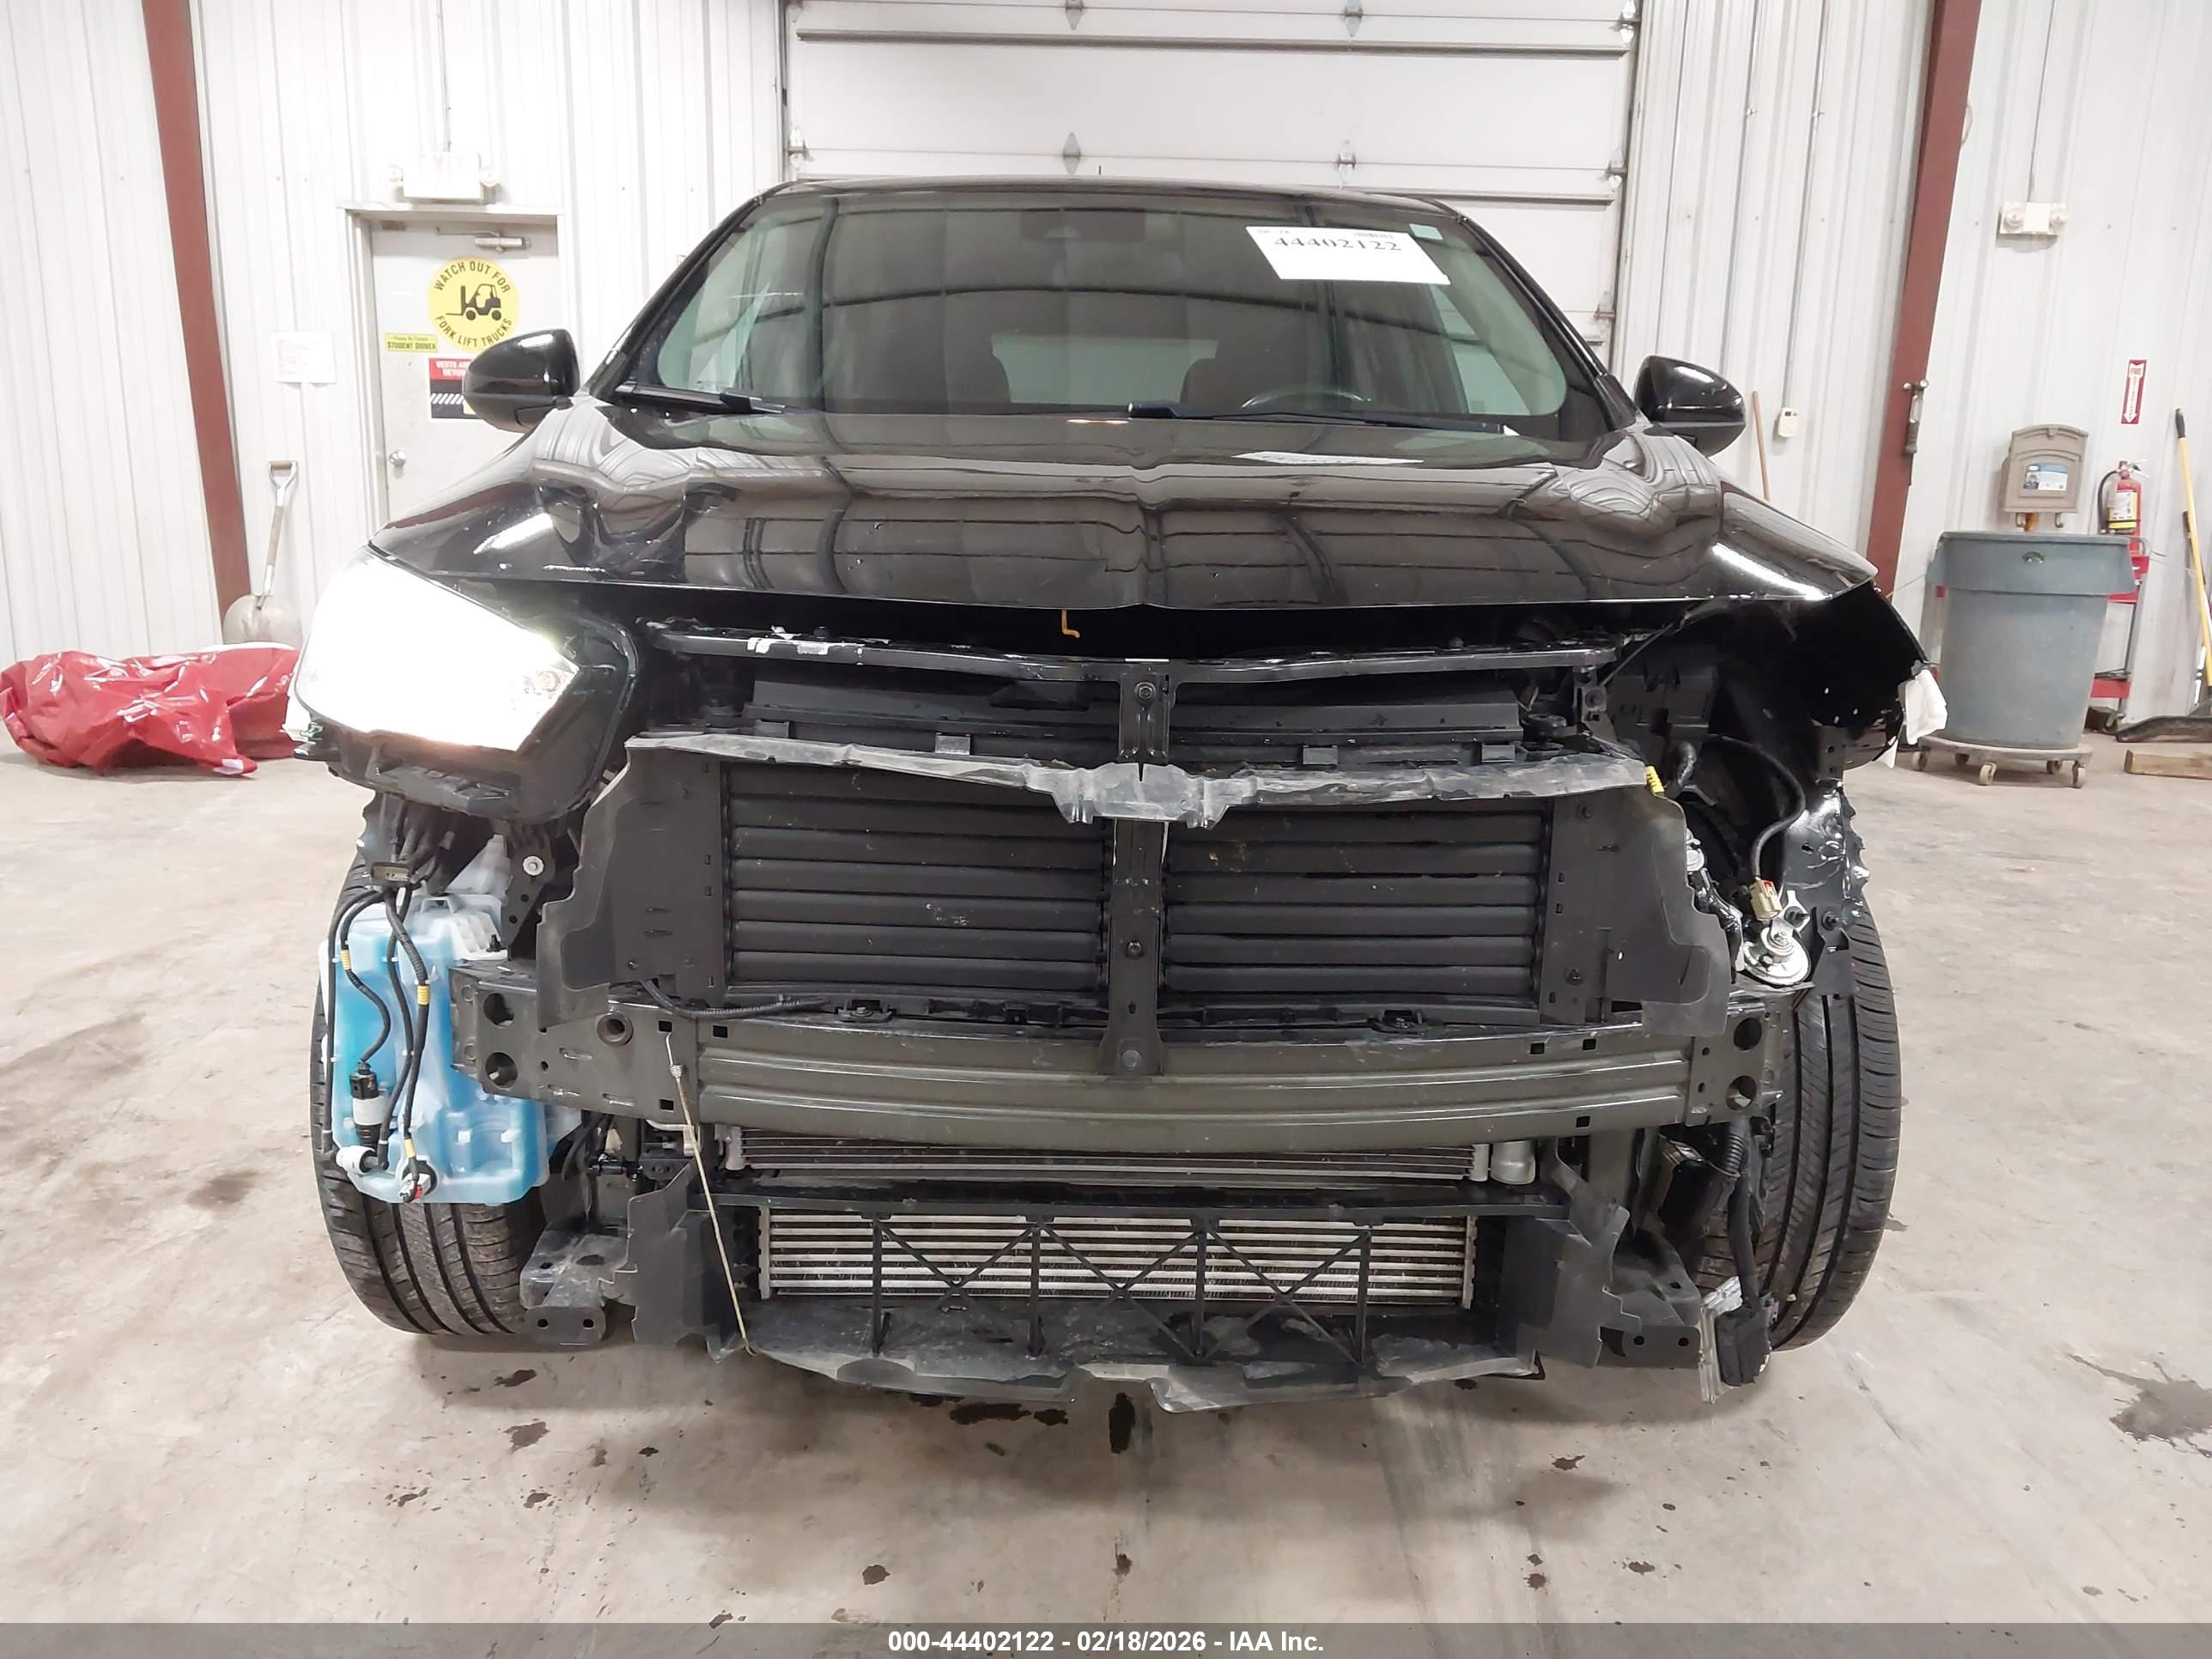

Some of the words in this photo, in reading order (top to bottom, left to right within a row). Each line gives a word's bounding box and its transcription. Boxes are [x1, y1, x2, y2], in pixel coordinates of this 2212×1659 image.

[1274, 237, 1402, 251] 44402122
[434, 261, 466, 291] WATCH
[469, 260, 492, 275] OUT
[492, 271, 511, 294] FOR
[434, 315, 457, 340] FORK
[457, 334, 477, 348] LIFT
[480, 318, 513, 347] TRUCKS
